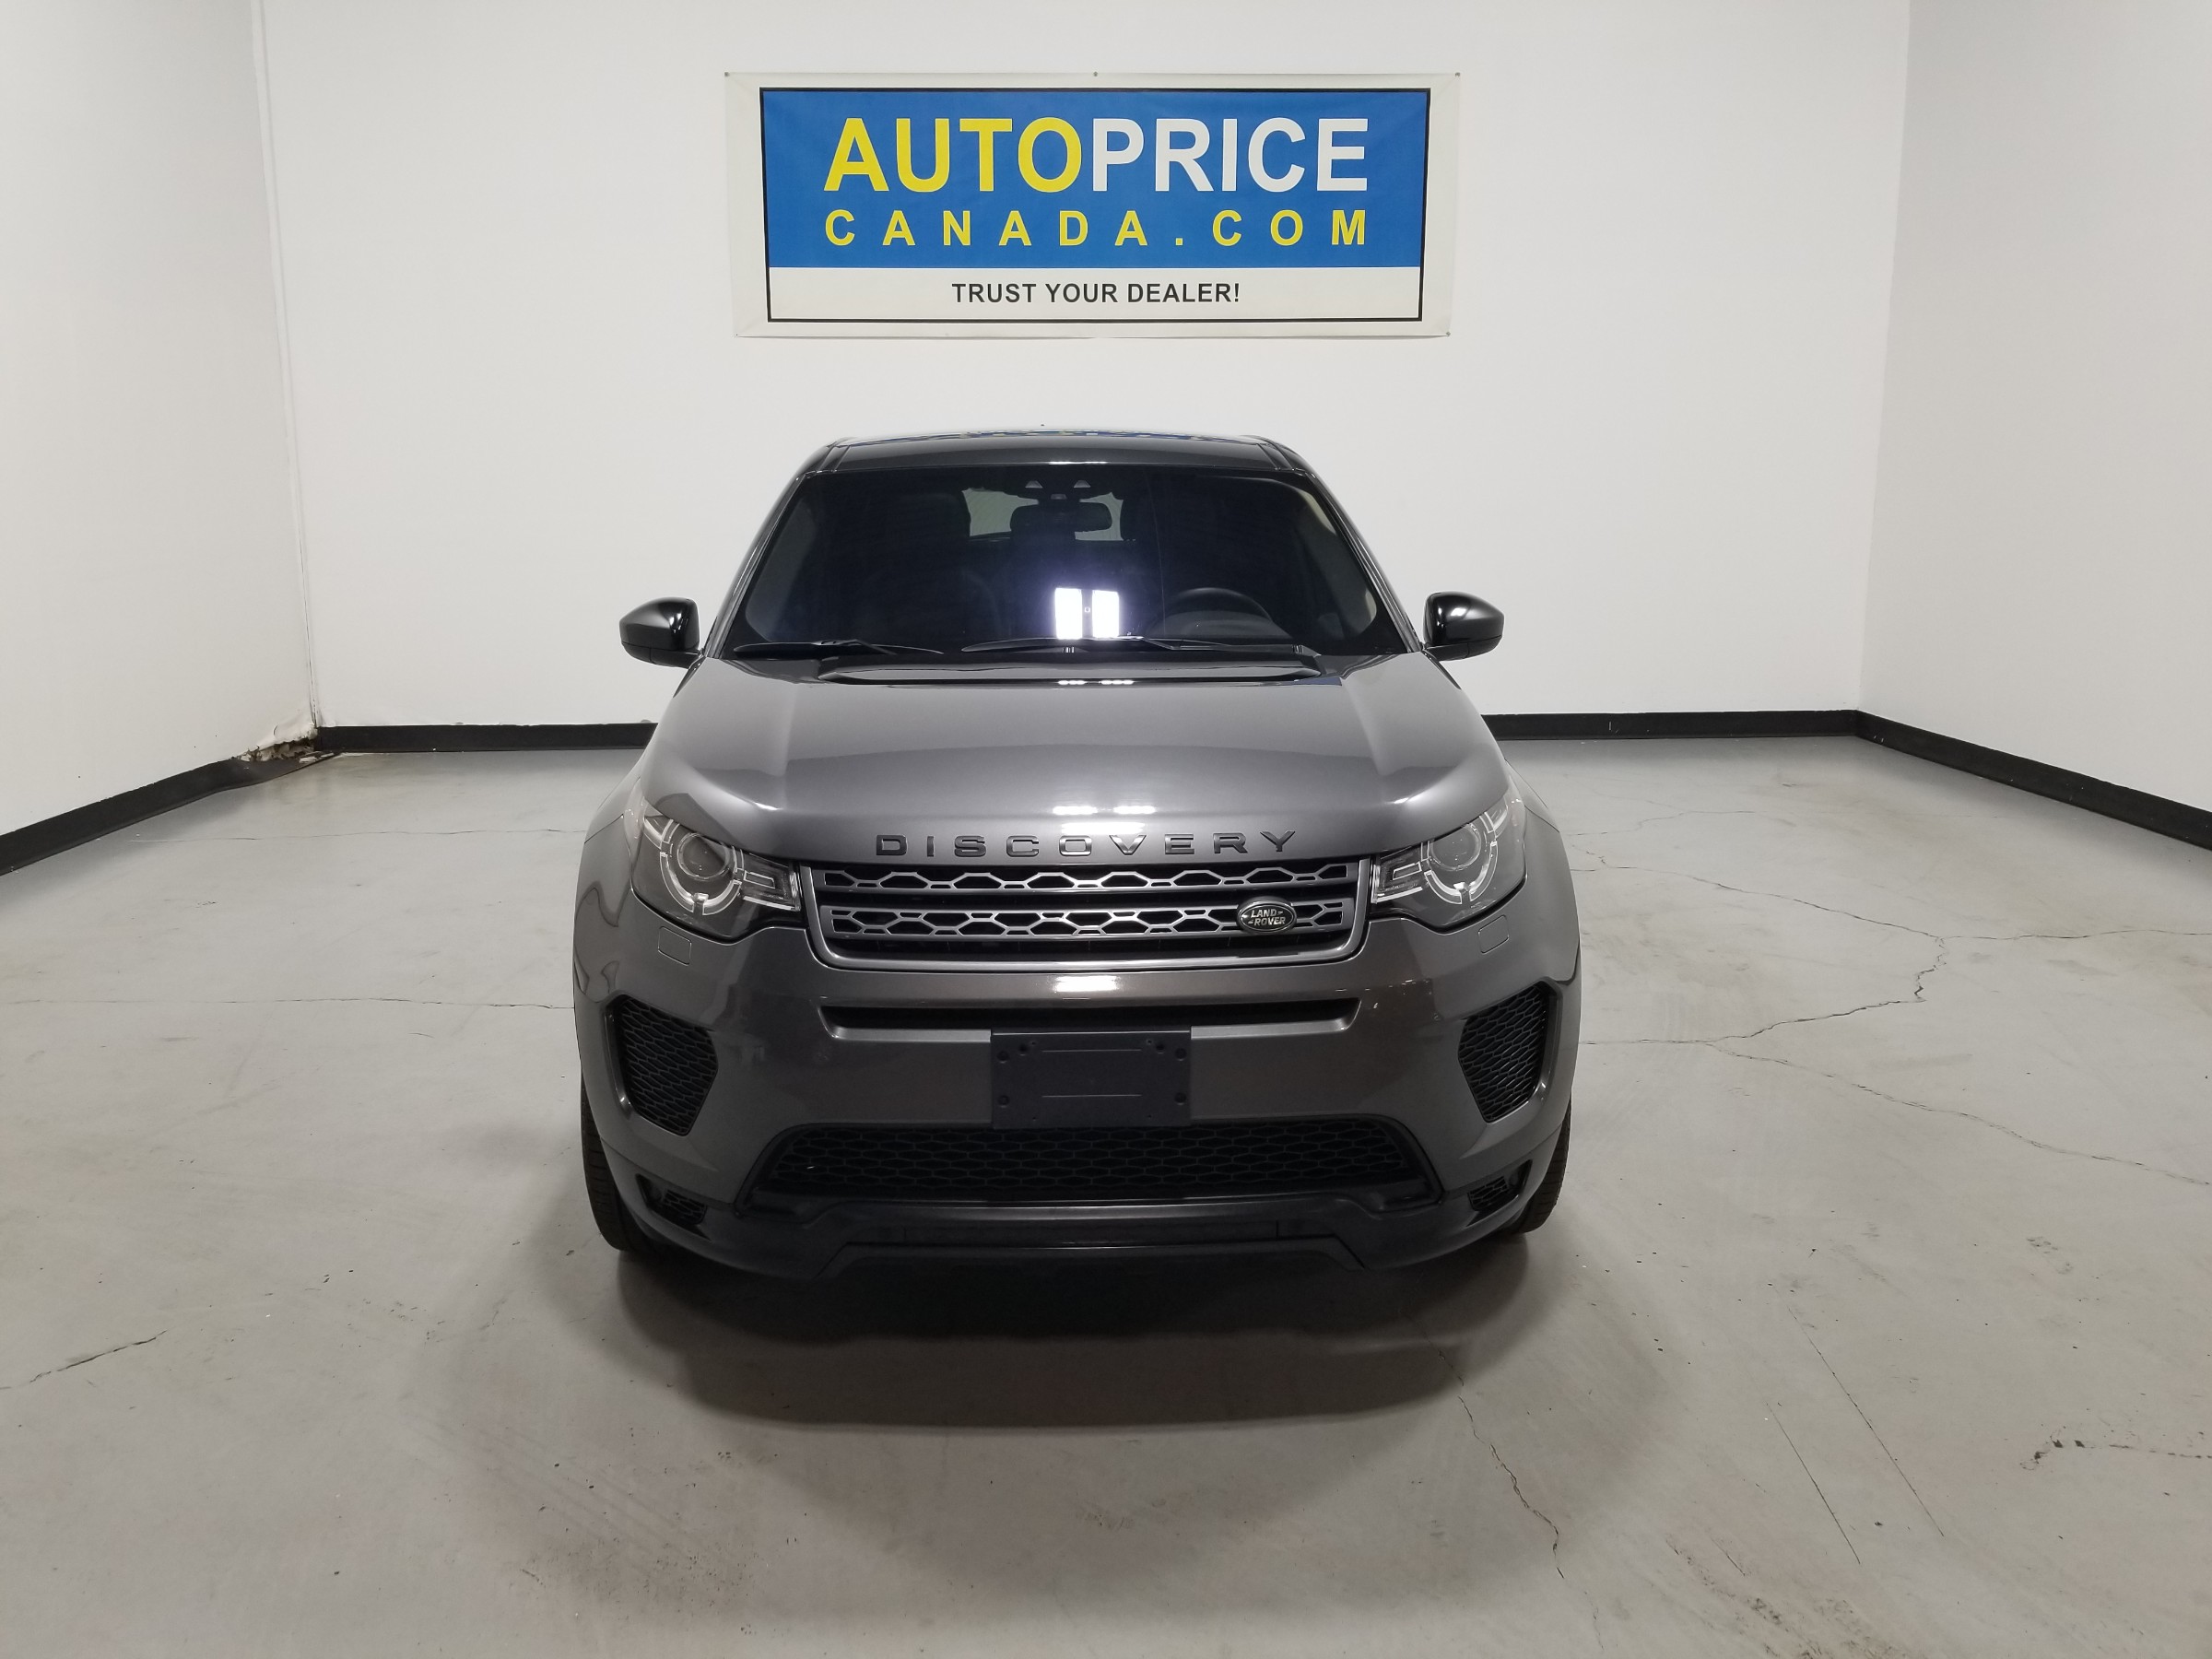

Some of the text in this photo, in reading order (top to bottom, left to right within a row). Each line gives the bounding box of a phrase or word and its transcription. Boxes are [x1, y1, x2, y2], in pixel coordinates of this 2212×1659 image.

[823, 116, 1370, 194] AUTOPRICE
[824, 208, 1367, 247] CANADA.COM
[951, 282, 1240, 303] TRUST YOUR DEALER!
[876, 830, 1296, 858] DISCOVERY
[1251, 908, 1277, 918] LAND
[1253, 916, 1286, 926] ROVER
